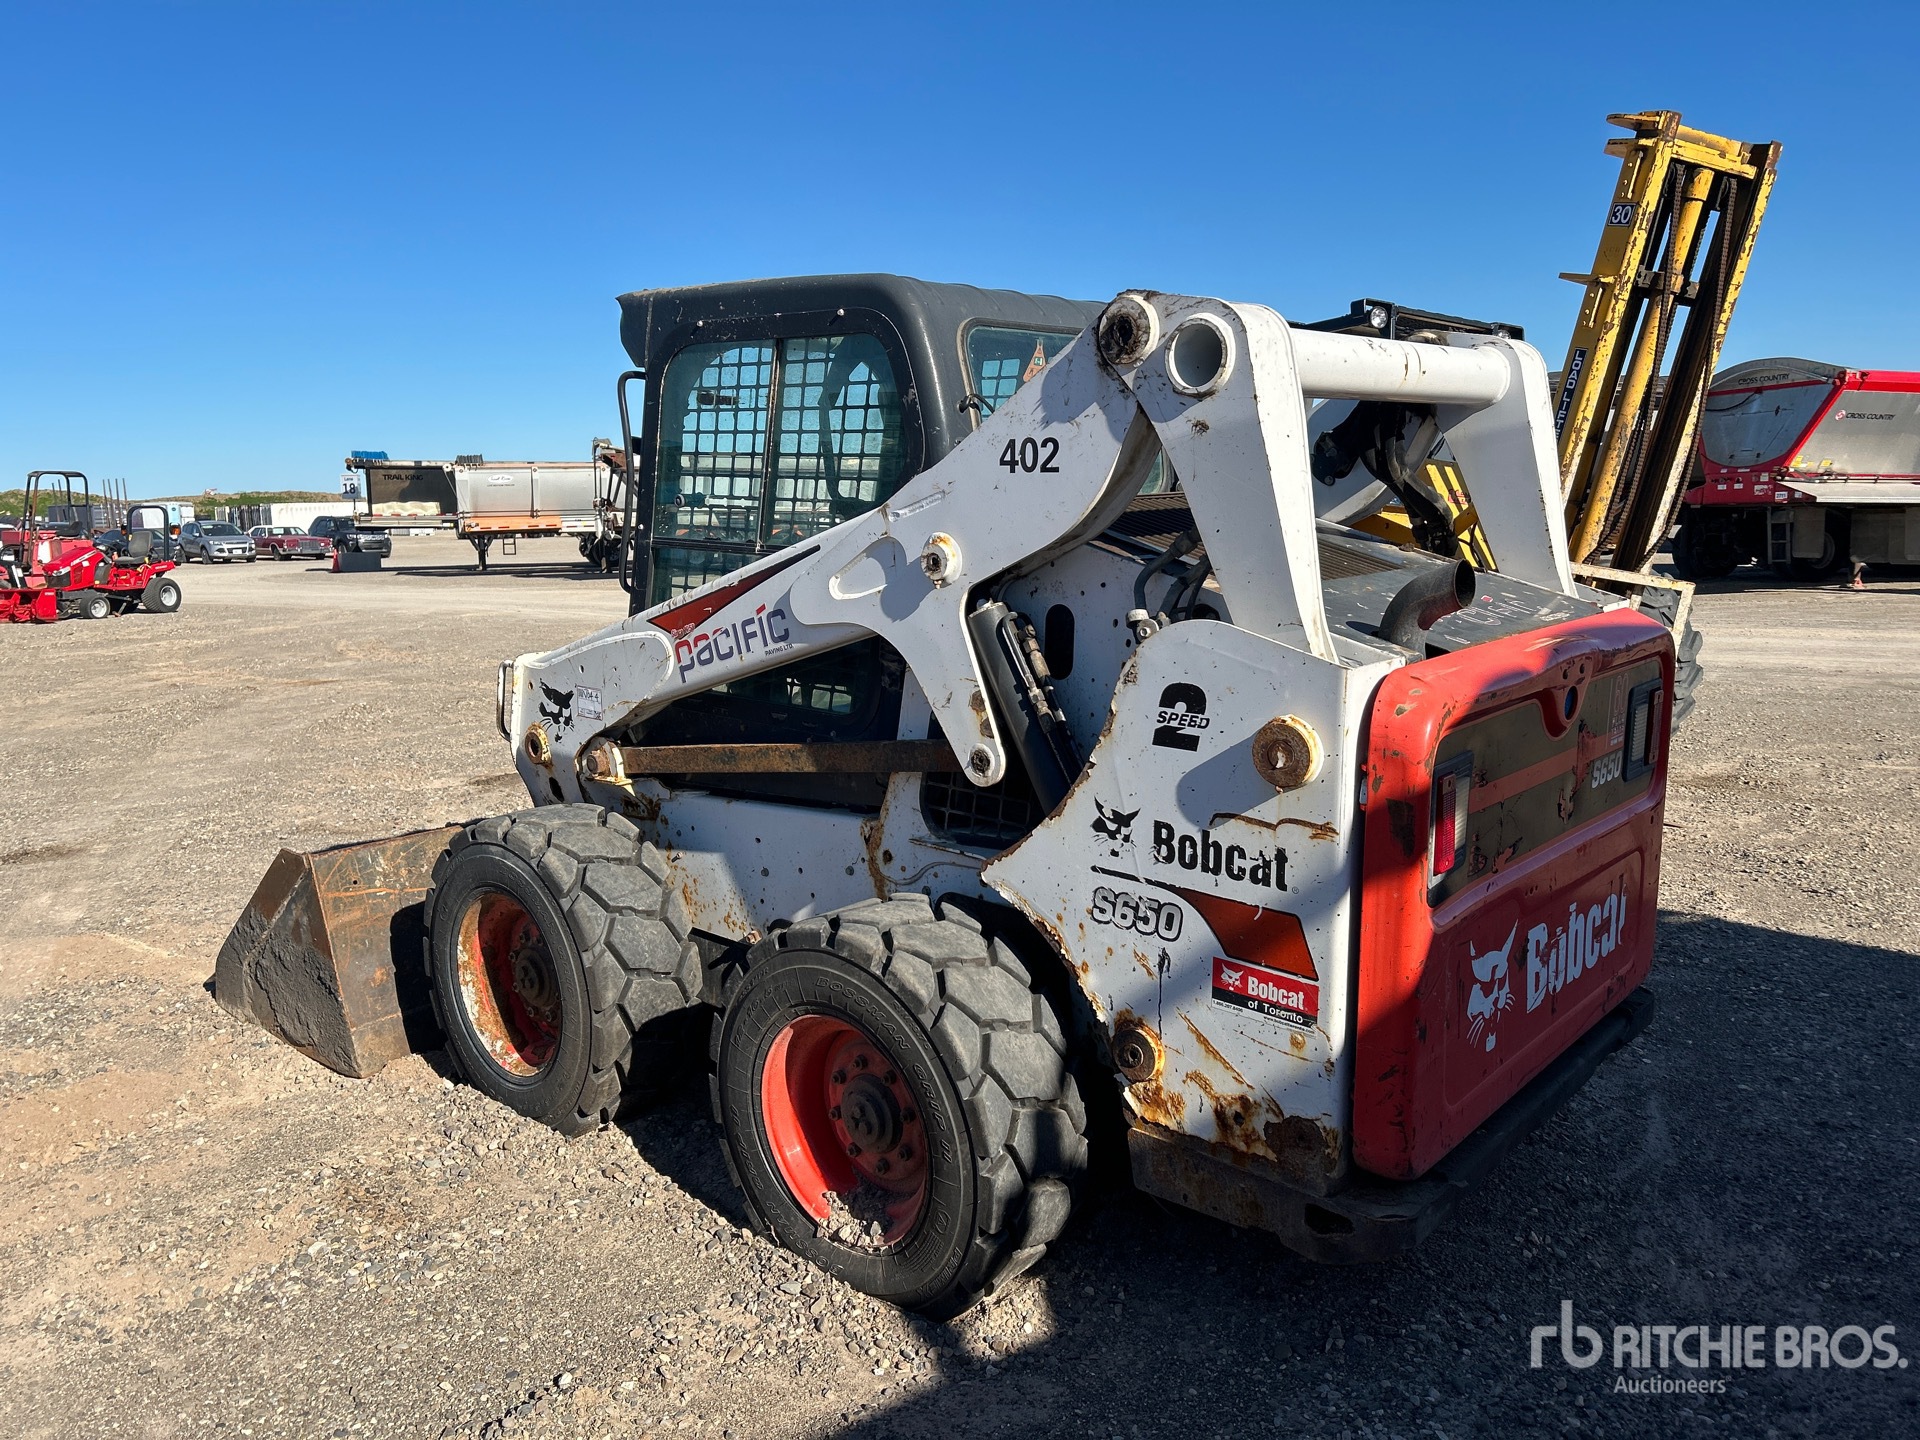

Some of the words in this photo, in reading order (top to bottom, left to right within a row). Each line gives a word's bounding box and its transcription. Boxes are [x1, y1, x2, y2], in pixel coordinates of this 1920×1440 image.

[1611, 205, 1632, 224] 30
[1565, 350, 1583, 389] LOAD
[1738, 376, 1758, 385] CROSS
[1759, 373, 1790, 382] COUNTRY
[1846, 412, 1867, 420] CROSS
[1866, 413, 1896, 421] COUNTRY
[999, 437, 1060, 474] 402
[342, 482, 356, 495] 18
[765, 645, 784, 656] PAVING
[1152, 682, 1207, 752] 2
[1156, 710, 1211, 729] SPEED
[1591, 750, 1623, 789] S650
[1153, 819, 1289, 892] Bobcat
[1091, 886, 1184, 942] S650
[1247, 975, 1305, 1011] Bobcat
[1247, 1000, 1259, 1010] of
[1262, 1002, 1304, 1024] Toronto
[814, 976, 911, 1050] BOSSMAN
[913, 1062, 947, 1131] GRIP
